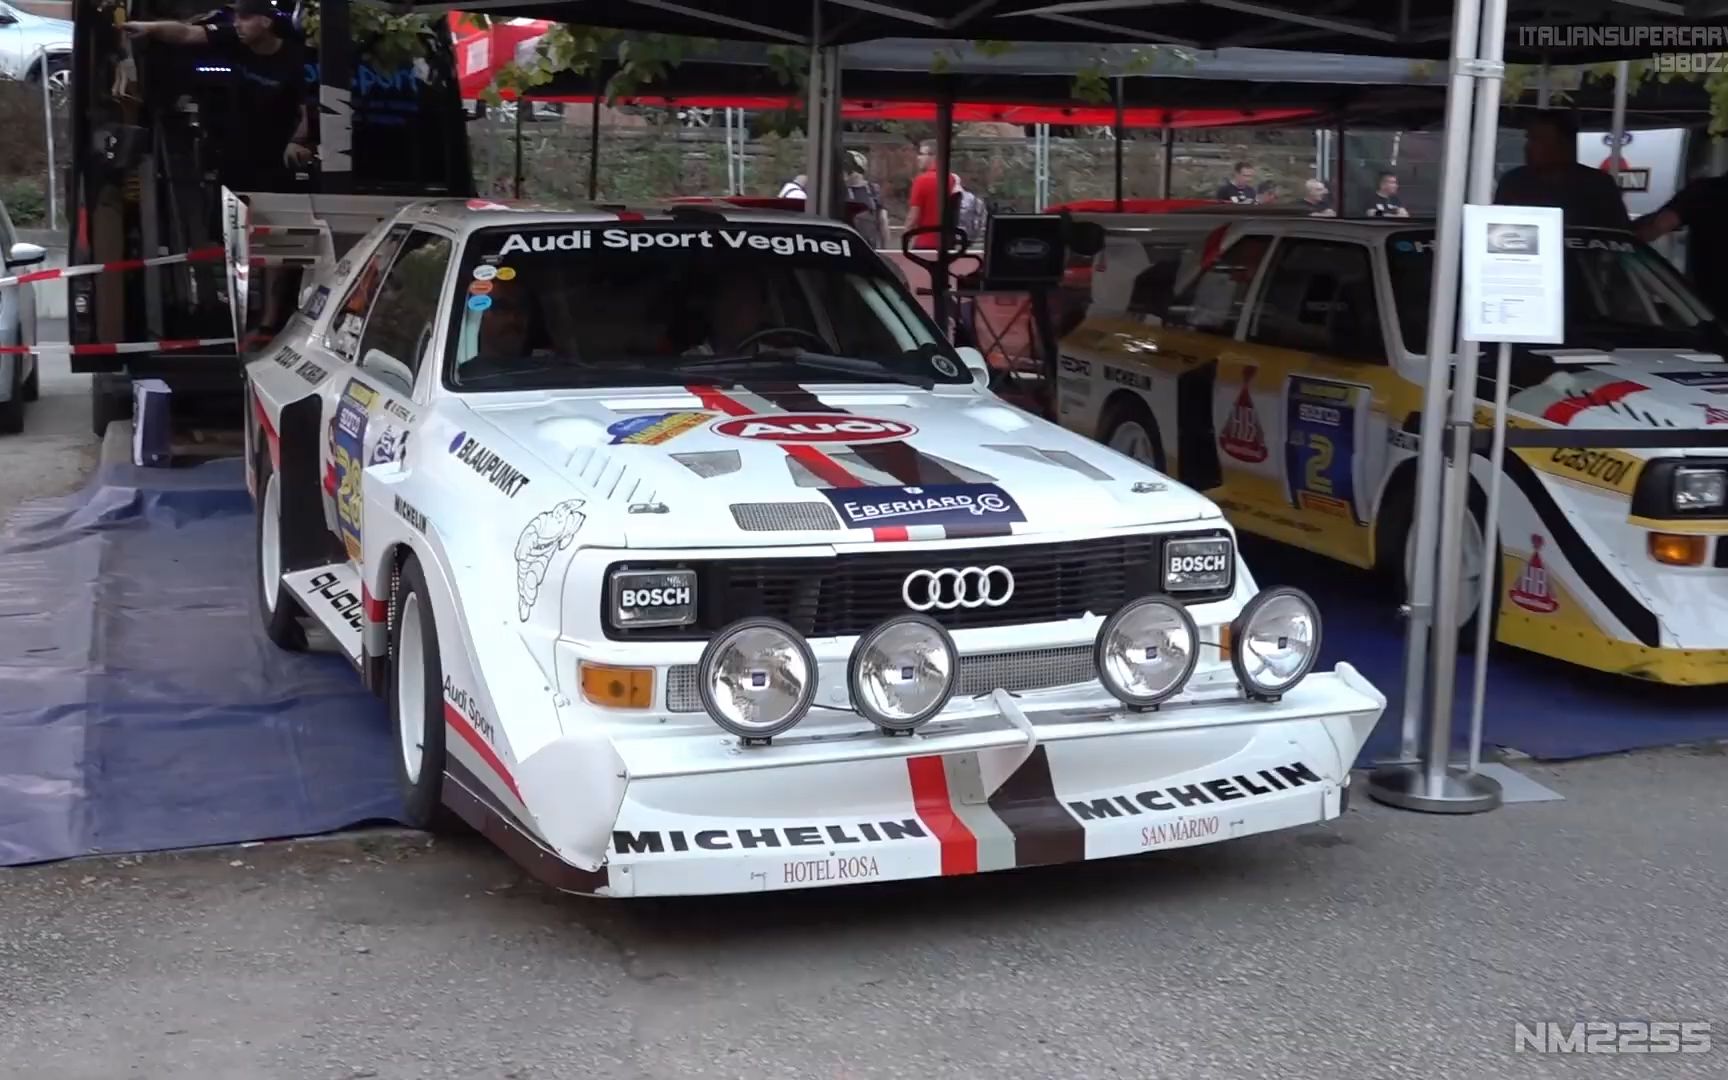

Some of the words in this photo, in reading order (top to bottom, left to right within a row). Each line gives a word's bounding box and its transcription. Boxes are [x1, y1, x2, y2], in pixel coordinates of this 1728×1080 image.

[500, 229, 592, 256] Audi
[602, 229, 713, 252] Sport
[718, 230, 852, 257] Veghel
[456, 437, 531, 498] BLAUPUNKT
[1304, 433, 1335, 495] 2
[394, 494, 427, 535] MICHELIN
[844, 495, 973, 521] EBERHARD
[1170, 555, 1226, 572] BOSCH
[622, 587, 690, 607] BOSCH
[443, 675, 468, 713] Audi
[467, 697, 496, 745] Sport
[1066, 761, 1323, 821] MICHELIN
[611, 818, 929, 854] MICHELIN
[1140, 822, 1167, 847] SAN
[1168, 815, 1220, 843] MARINO
[783, 860, 835, 883] HOTEL
[838, 855, 880, 879] ROSA
